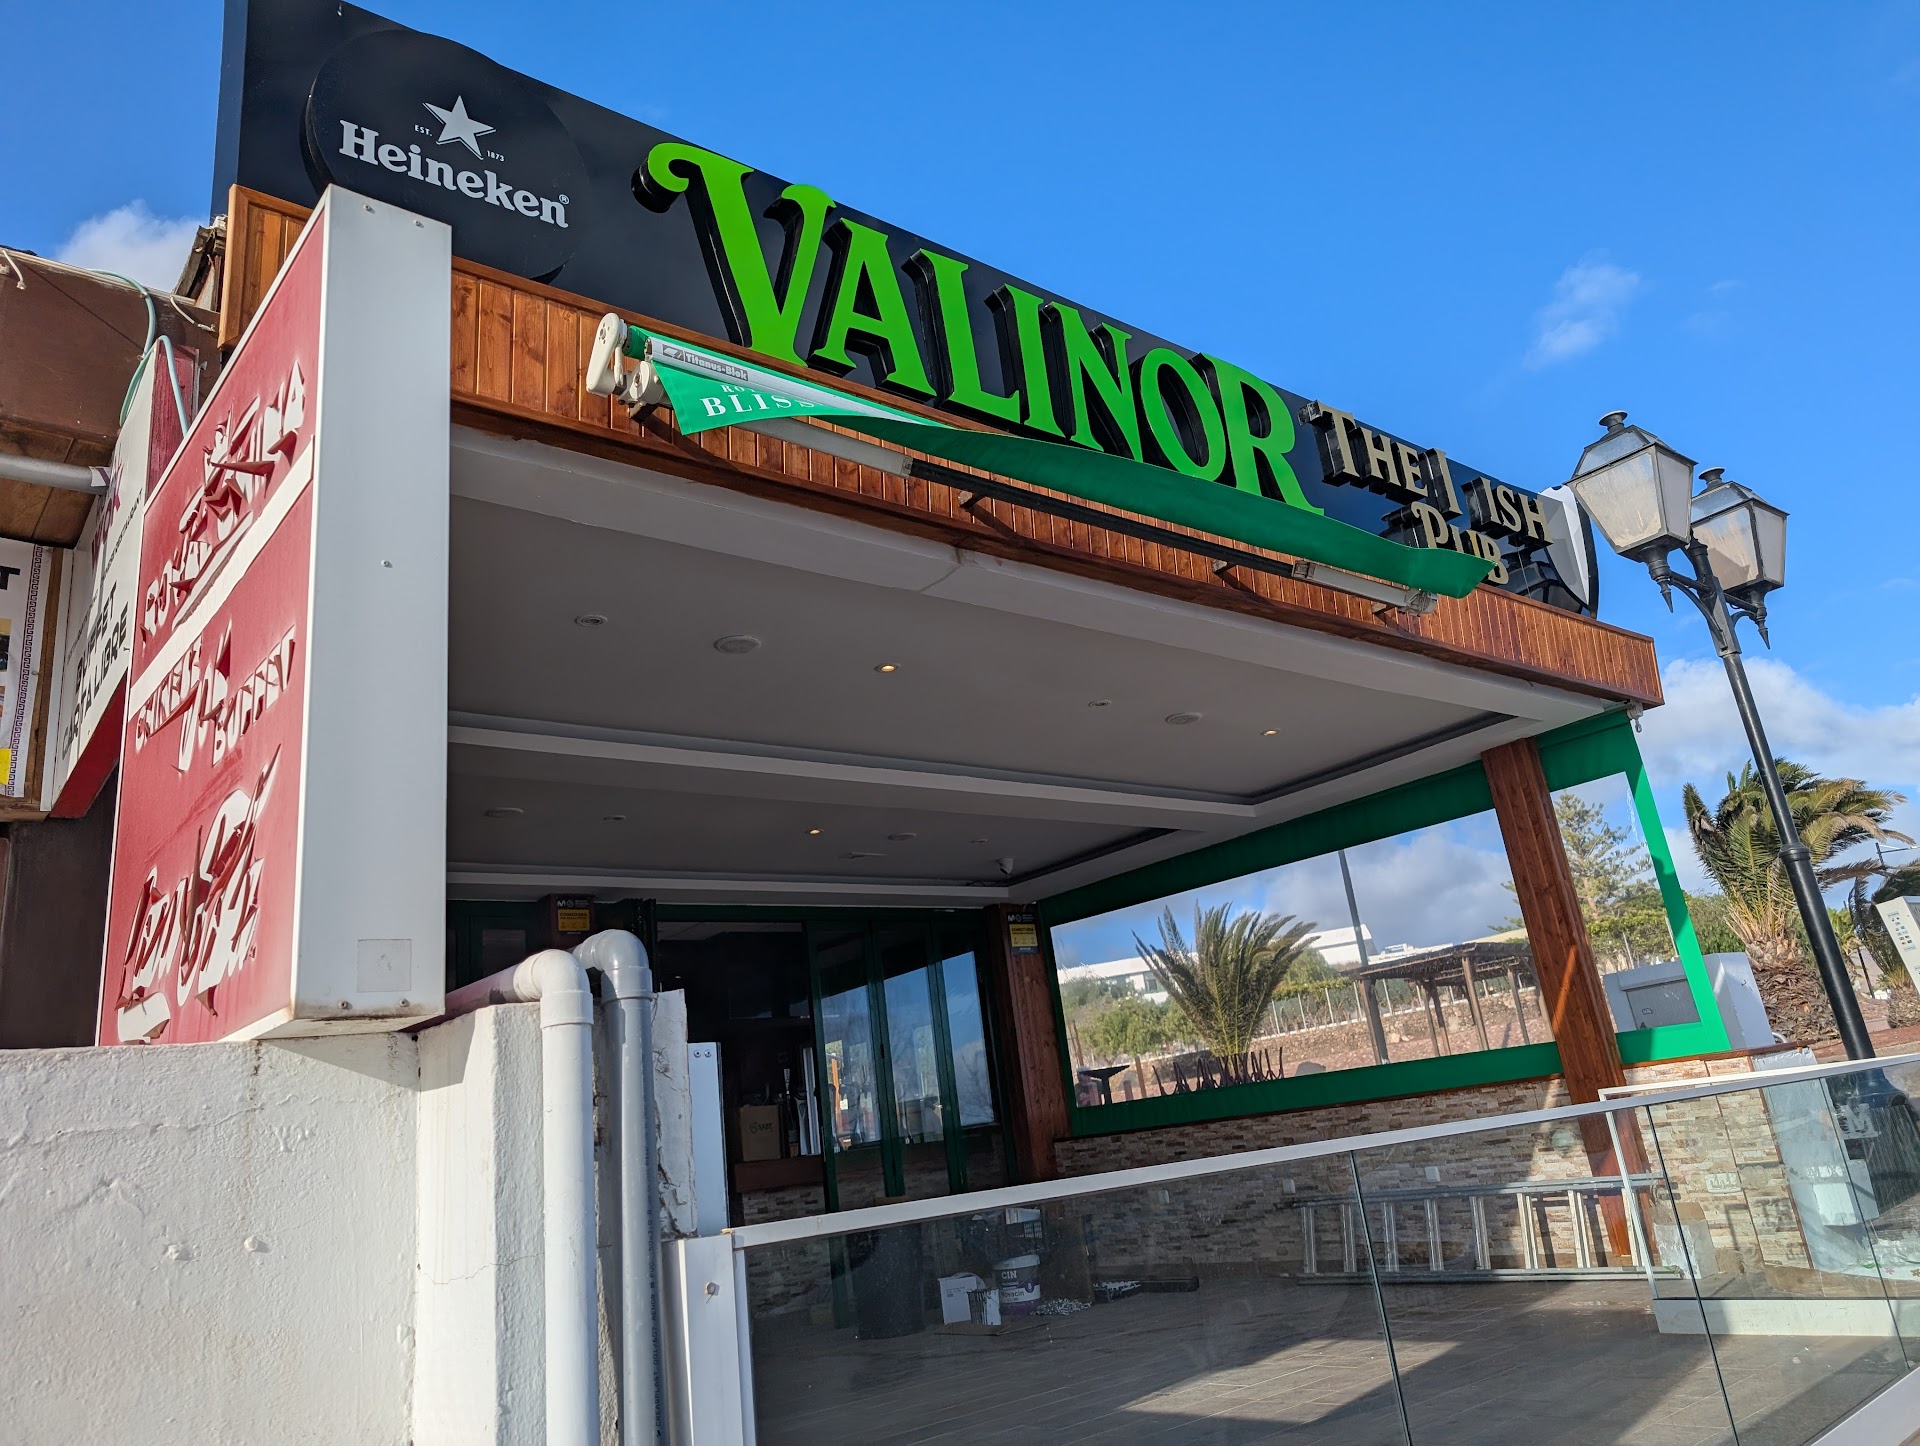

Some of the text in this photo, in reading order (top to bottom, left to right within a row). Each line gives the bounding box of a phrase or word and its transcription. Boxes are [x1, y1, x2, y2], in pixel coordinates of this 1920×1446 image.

[415, 124, 433, 137] EST.
[487, 150, 505, 162] 1873
[648, 142, 1324, 516] VALINOR
[685, 352, 748, 382] Titanus-Blok
[1317, 402, 1429, 498] THE
[76, 580, 117, 695] BUFFET
[62, 601, 129, 760] CARTA LIBRE
[1001, 1270, 1017, 1280] CIN
